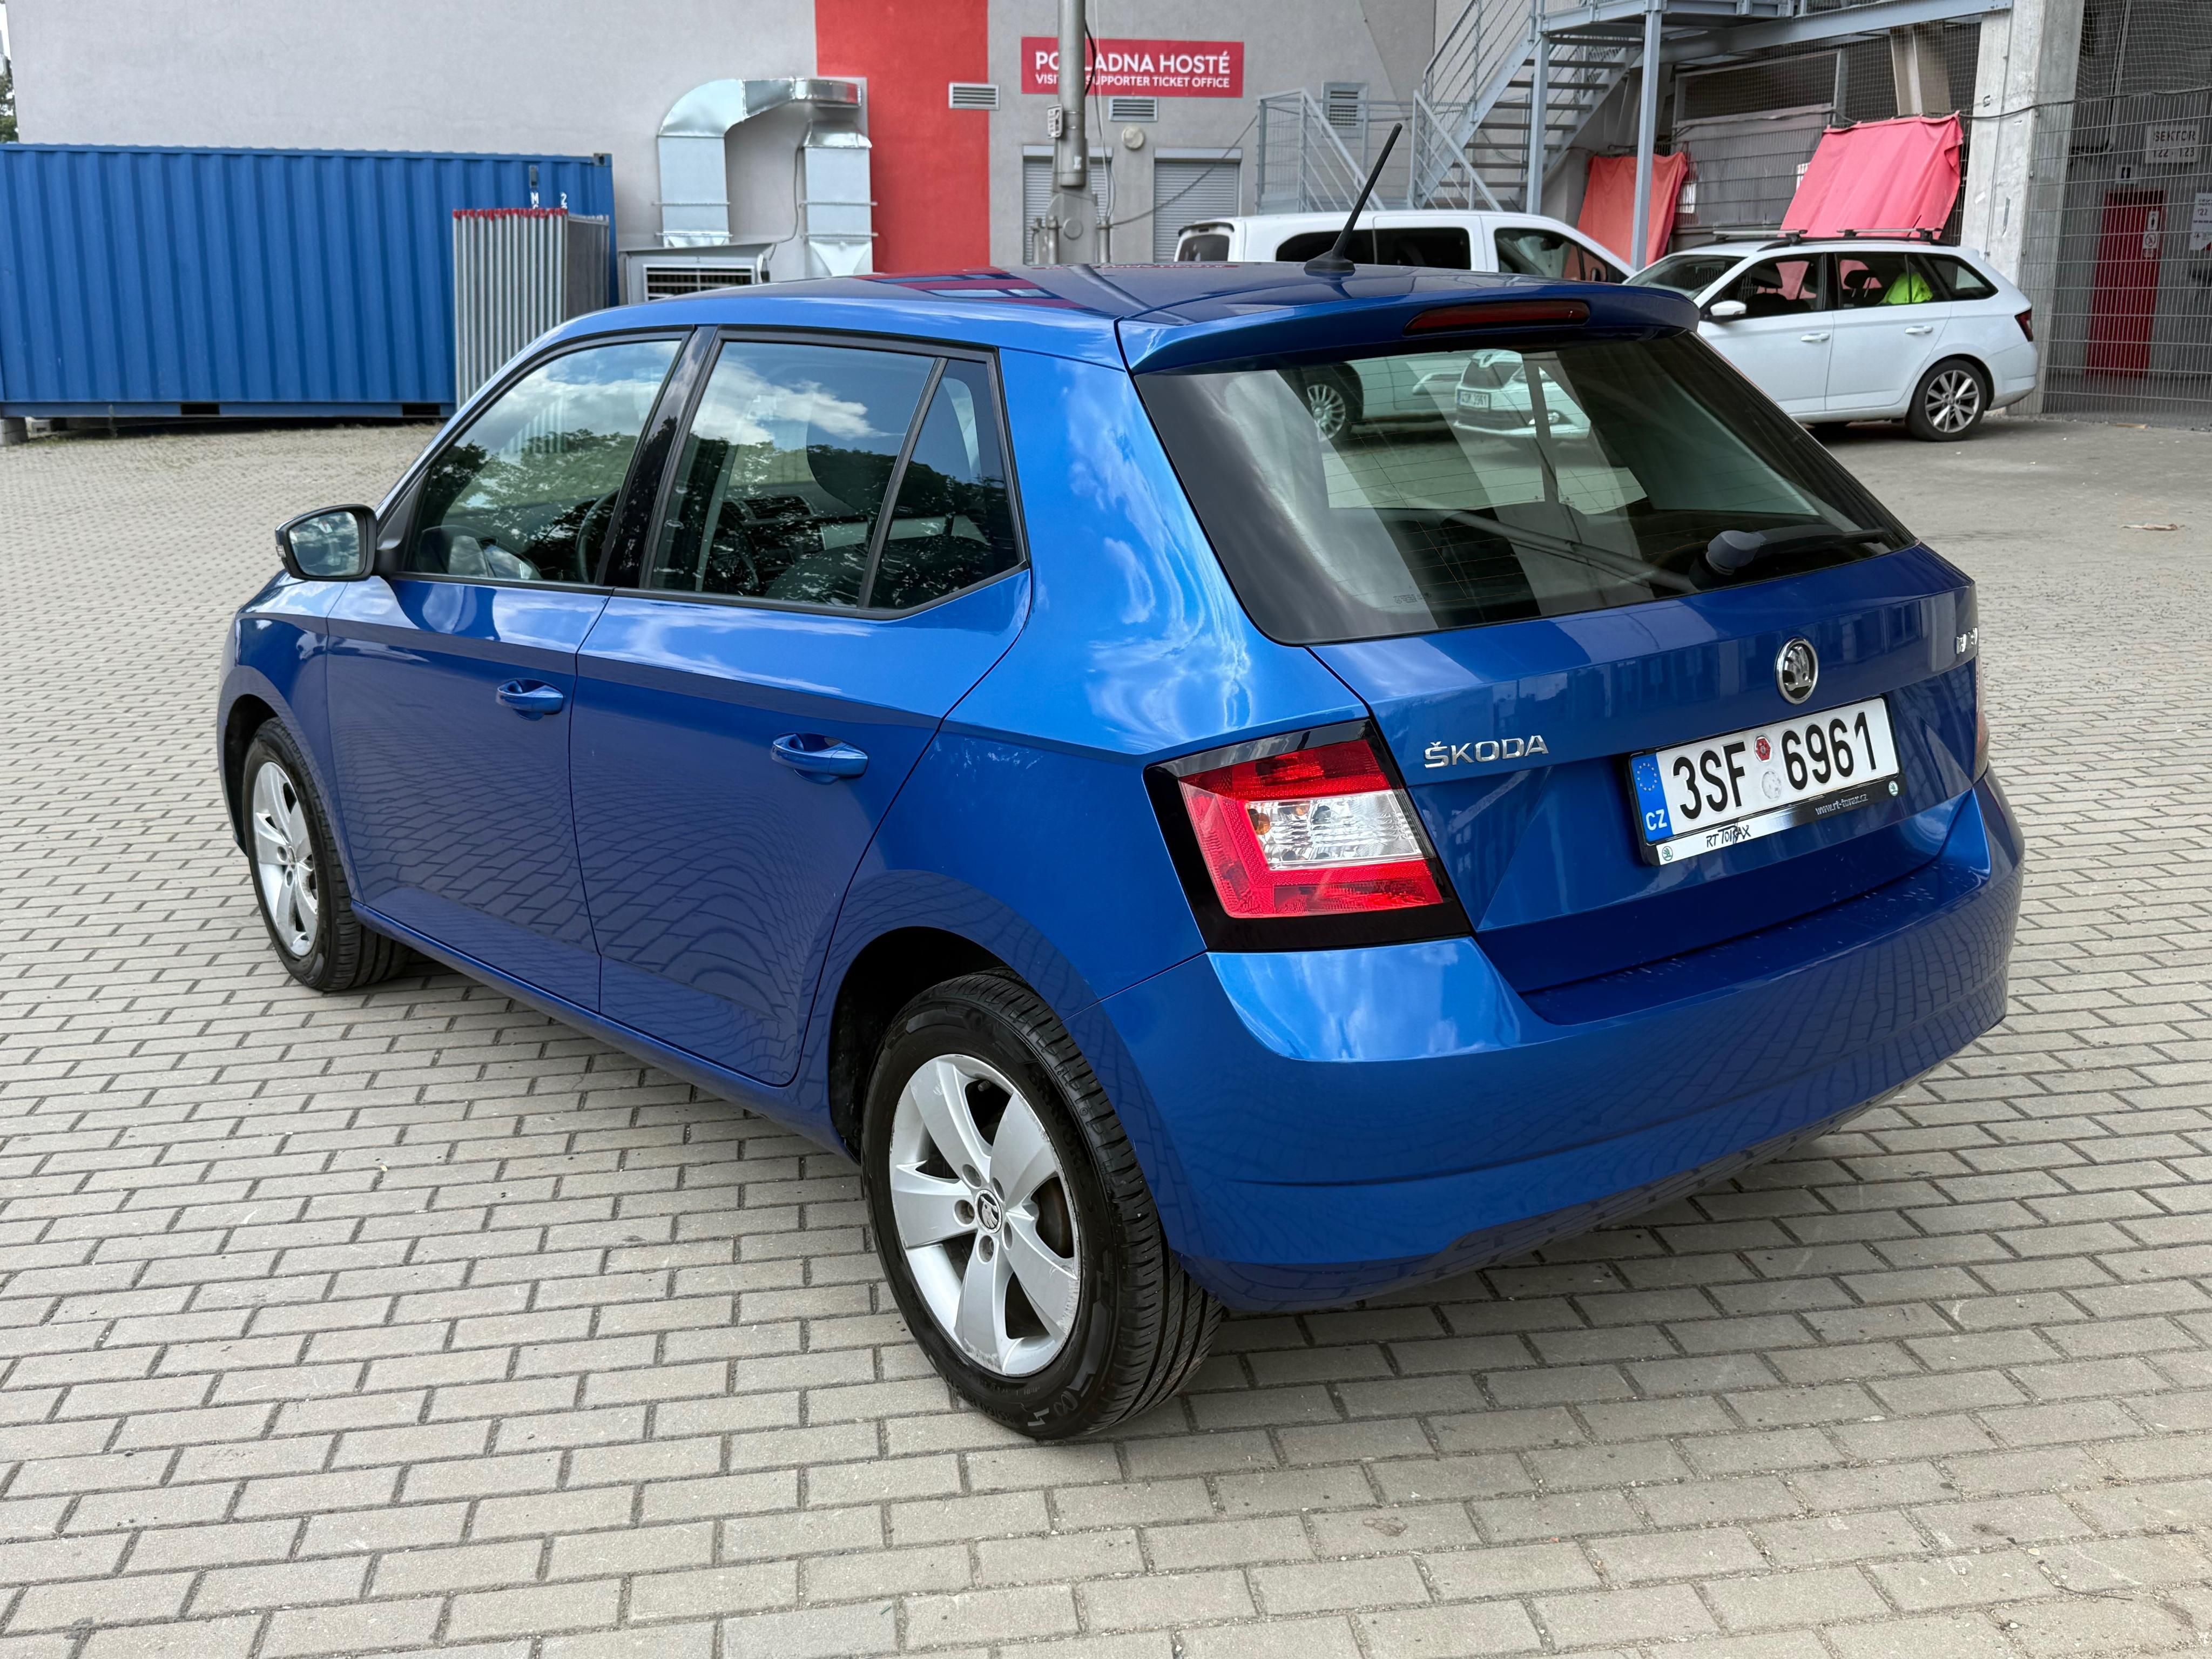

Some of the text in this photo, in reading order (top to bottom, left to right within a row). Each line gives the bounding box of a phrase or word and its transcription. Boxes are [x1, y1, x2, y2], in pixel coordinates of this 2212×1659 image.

[1159, 51, 1230, 74] HOSTÉ
[1152, 76, 1190, 87] TICKET
[1191, 77, 1230, 88] OFFICE
[2154, 131, 2196, 141] SEKTOR
[1424, 735, 1549, 768] ŠKODA
[1673, 712, 1876, 819] 3SF 6961
[1646, 809, 1668, 831] CZ
[1706, 833, 1719, 848] RT
